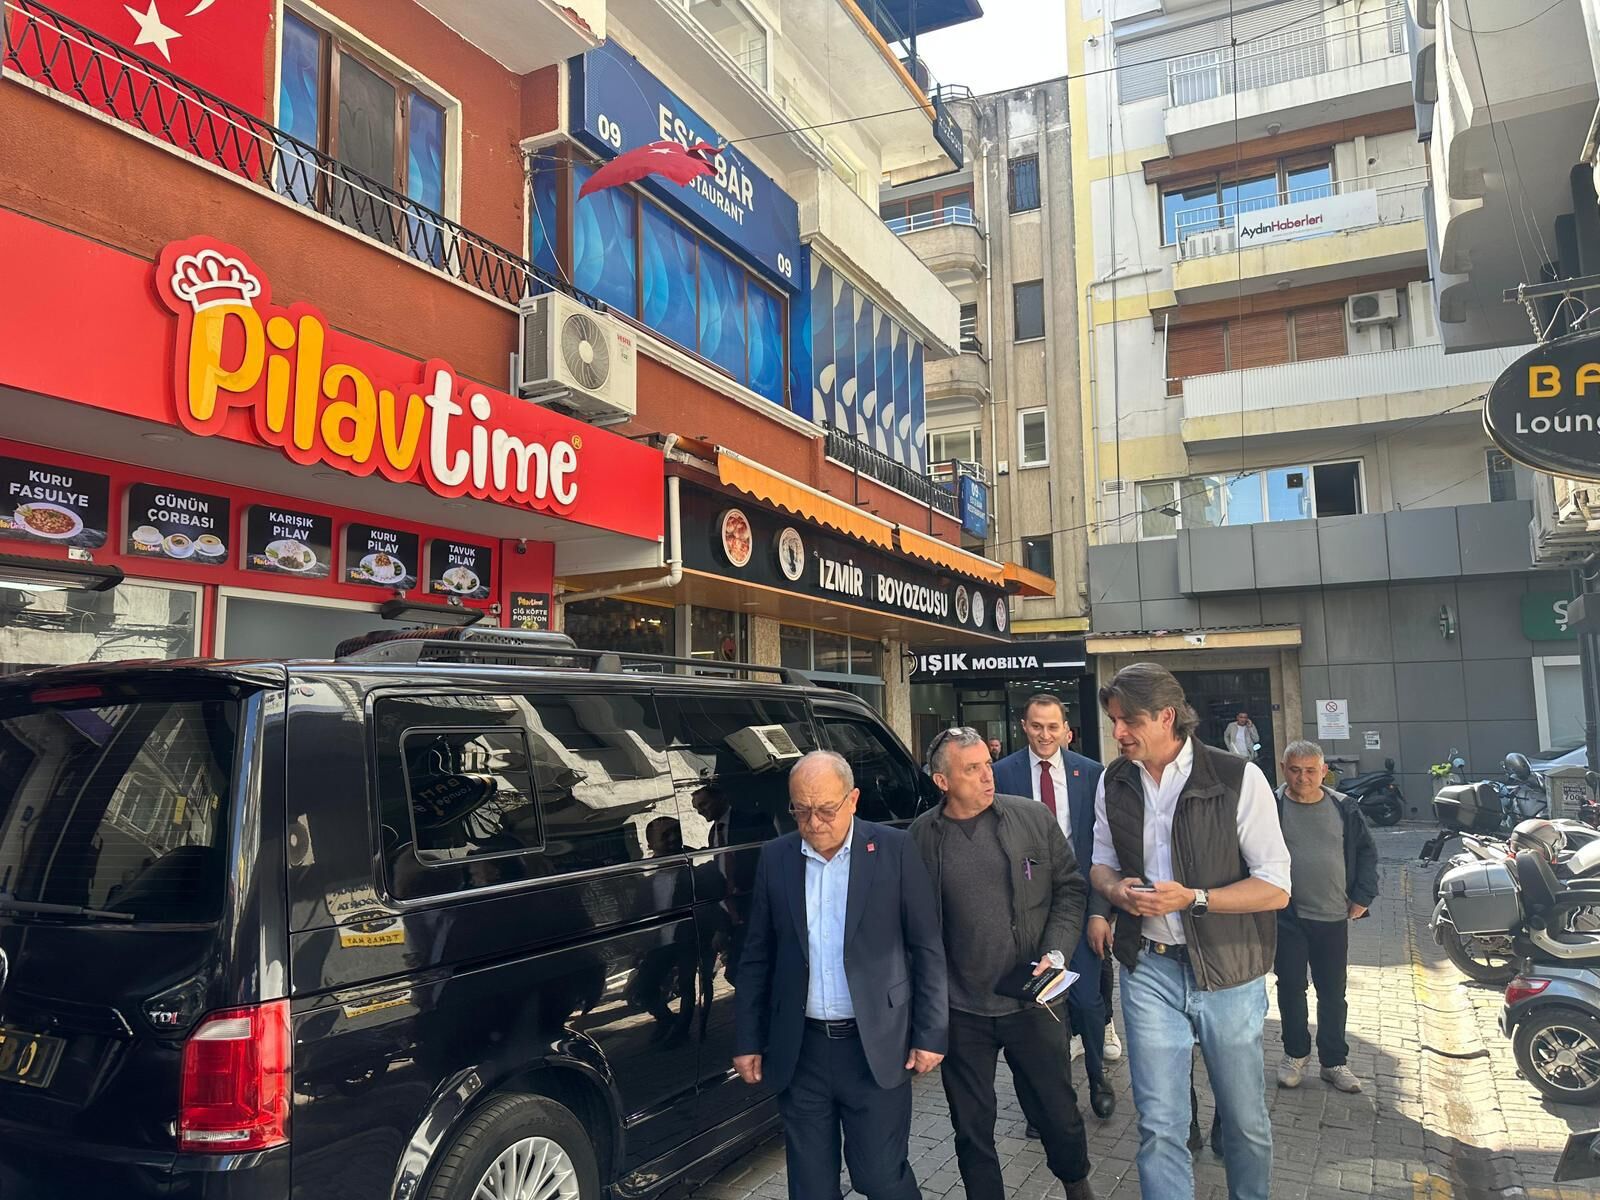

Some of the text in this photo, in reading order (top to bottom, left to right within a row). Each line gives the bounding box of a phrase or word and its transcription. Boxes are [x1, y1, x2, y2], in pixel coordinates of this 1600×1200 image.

[598, 114, 622, 149] 09
[714, 153, 754, 212] BAR
[777, 252, 792, 279] 09
[1515, 412, 1600, 435] Loun
[29, 469, 73, 488] KURU
[8, 482, 89, 508] FASULYE
[155, 493, 209, 514] GÜNÜN
[147, 508, 215, 529] ÇORBASI
[269, 511, 313, 529] KARIŞIK
[370, 530, 397, 543] KURU
[448, 544, 476, 556] TAVUK
[877, 573, 948, 618] BOYOZCUSU
[920, 652, 969, 676] IŞIK
[149, 1010, 178, 1025] TDI
